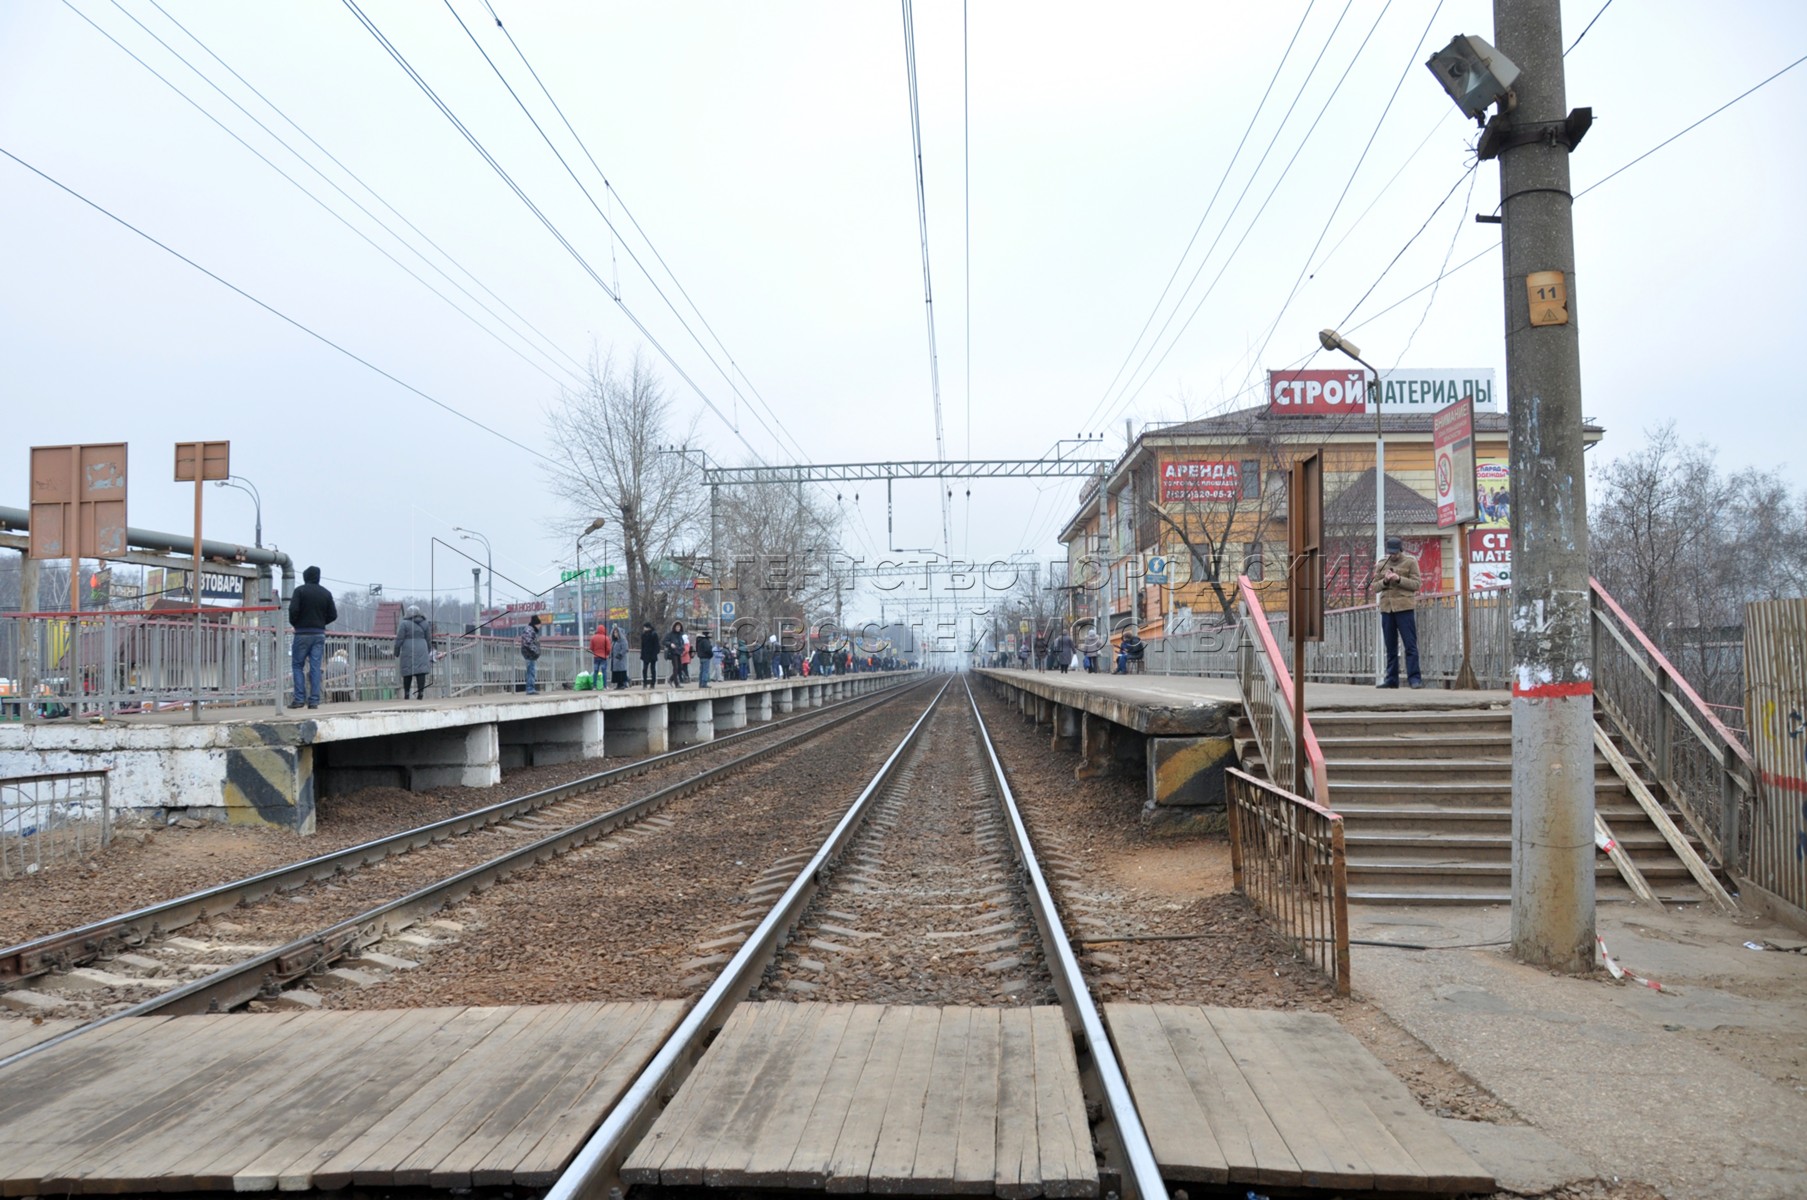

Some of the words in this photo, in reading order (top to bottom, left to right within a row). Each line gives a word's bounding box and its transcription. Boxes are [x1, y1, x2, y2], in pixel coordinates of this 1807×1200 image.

[1537, 286, 1556, 300] 11
[1165, 464, 1238, 479] АРЕНДА
[1482, 533, 1508, 548] СТ
[187, 571, 244, 594] ХЗТОВАРЫ
